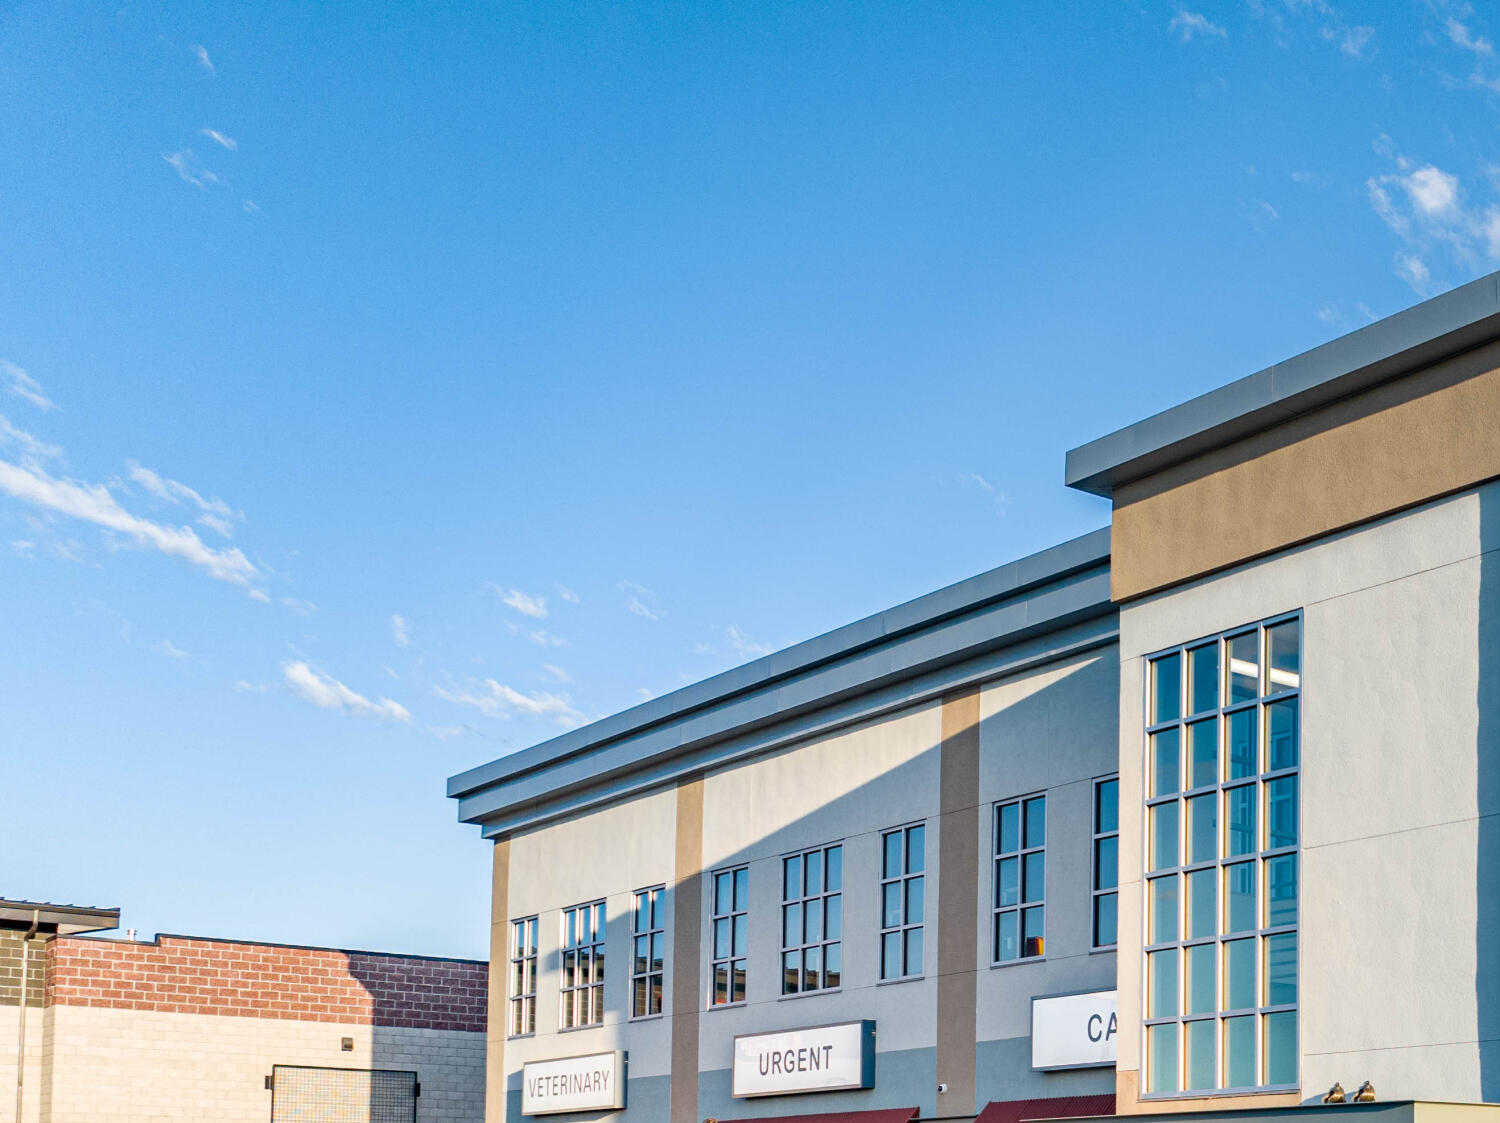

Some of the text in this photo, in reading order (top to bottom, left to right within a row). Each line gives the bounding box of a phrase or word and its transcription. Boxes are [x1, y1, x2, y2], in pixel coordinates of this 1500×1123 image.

[1087, 1011, 1117, 1042] CA
[759, 1045, 833, 1076] URGENT
[528, 1070, 610, 1098] VETERINARY
